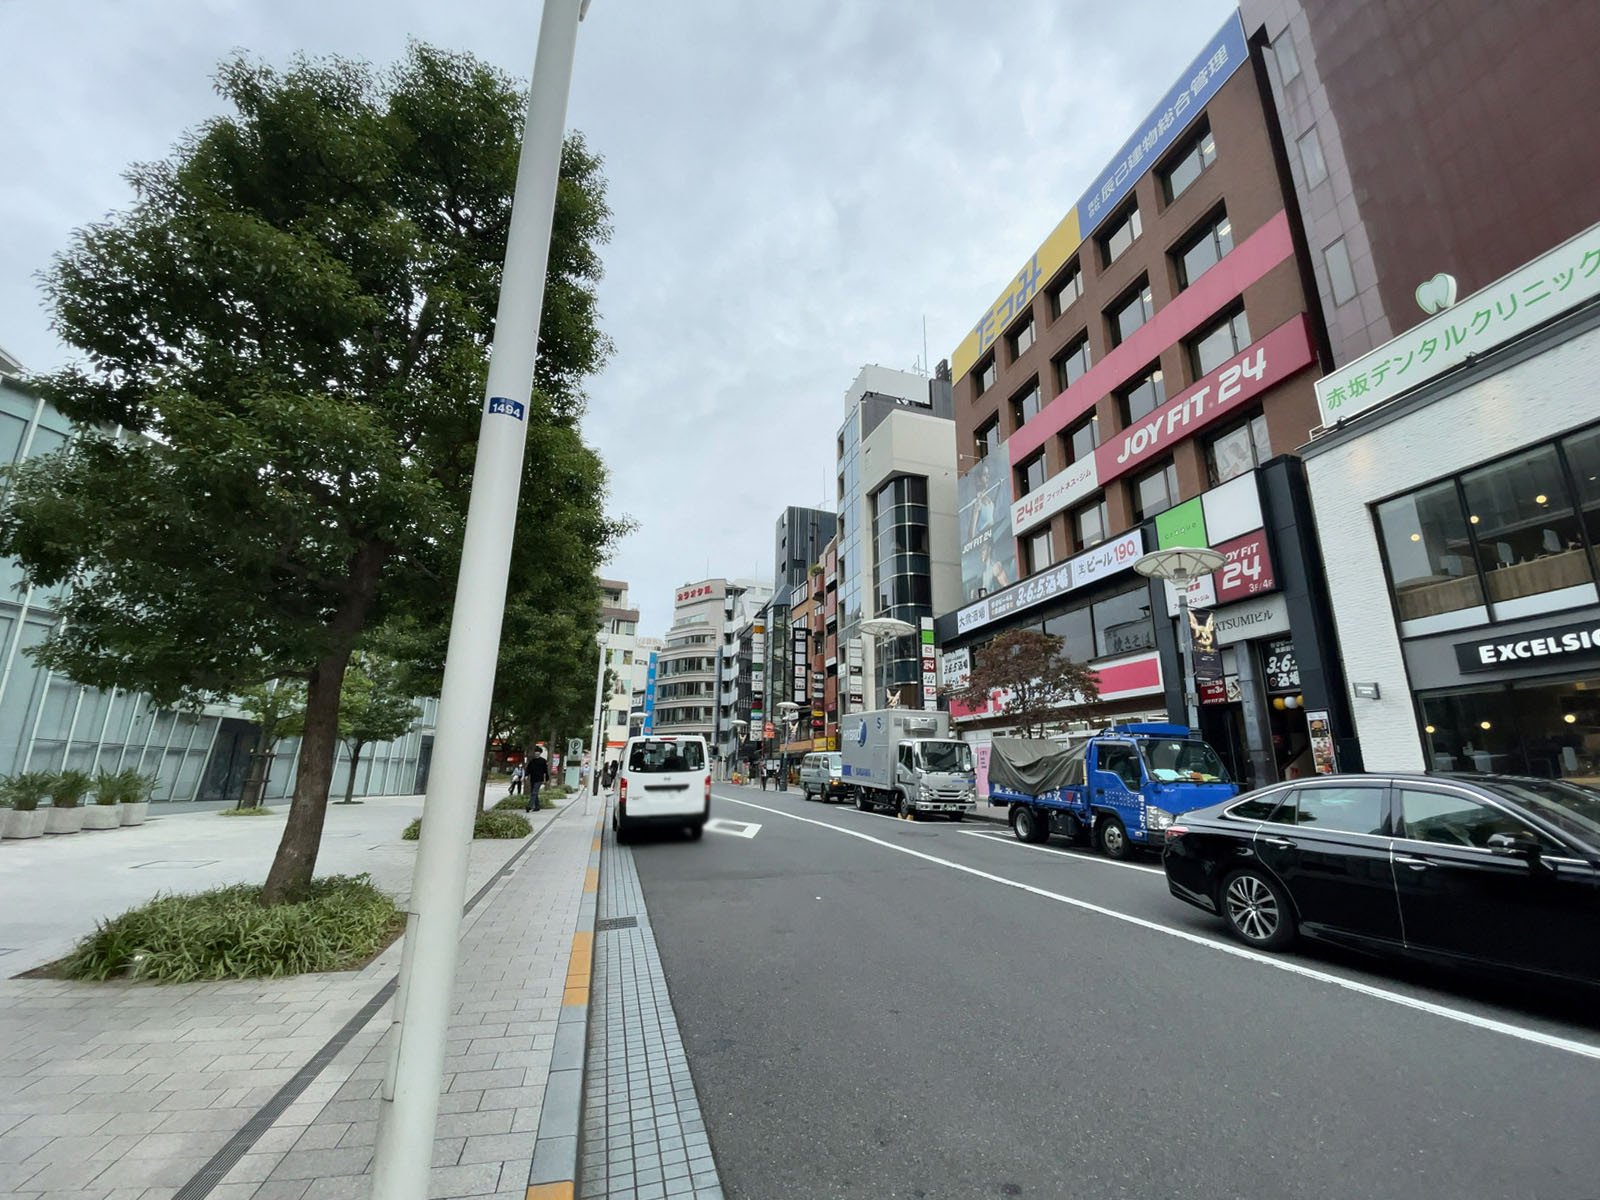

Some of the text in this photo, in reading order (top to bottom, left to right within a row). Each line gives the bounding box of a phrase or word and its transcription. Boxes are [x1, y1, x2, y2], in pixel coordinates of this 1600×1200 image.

[975, 252, 1042, 356] たつみ
[1326, 248, 1600, 411] 赤坂デンタルクリニック
[1218, 347, 1267, 404] 24
[492, 403, 521, 418] 1494
[1016, 501, 1033, 524] 24
[1114, 540, 1136, 562] 190
[1222, 555, 1261, 590] 24
[1214, 609, 1273, 632] ATSUMIビル
